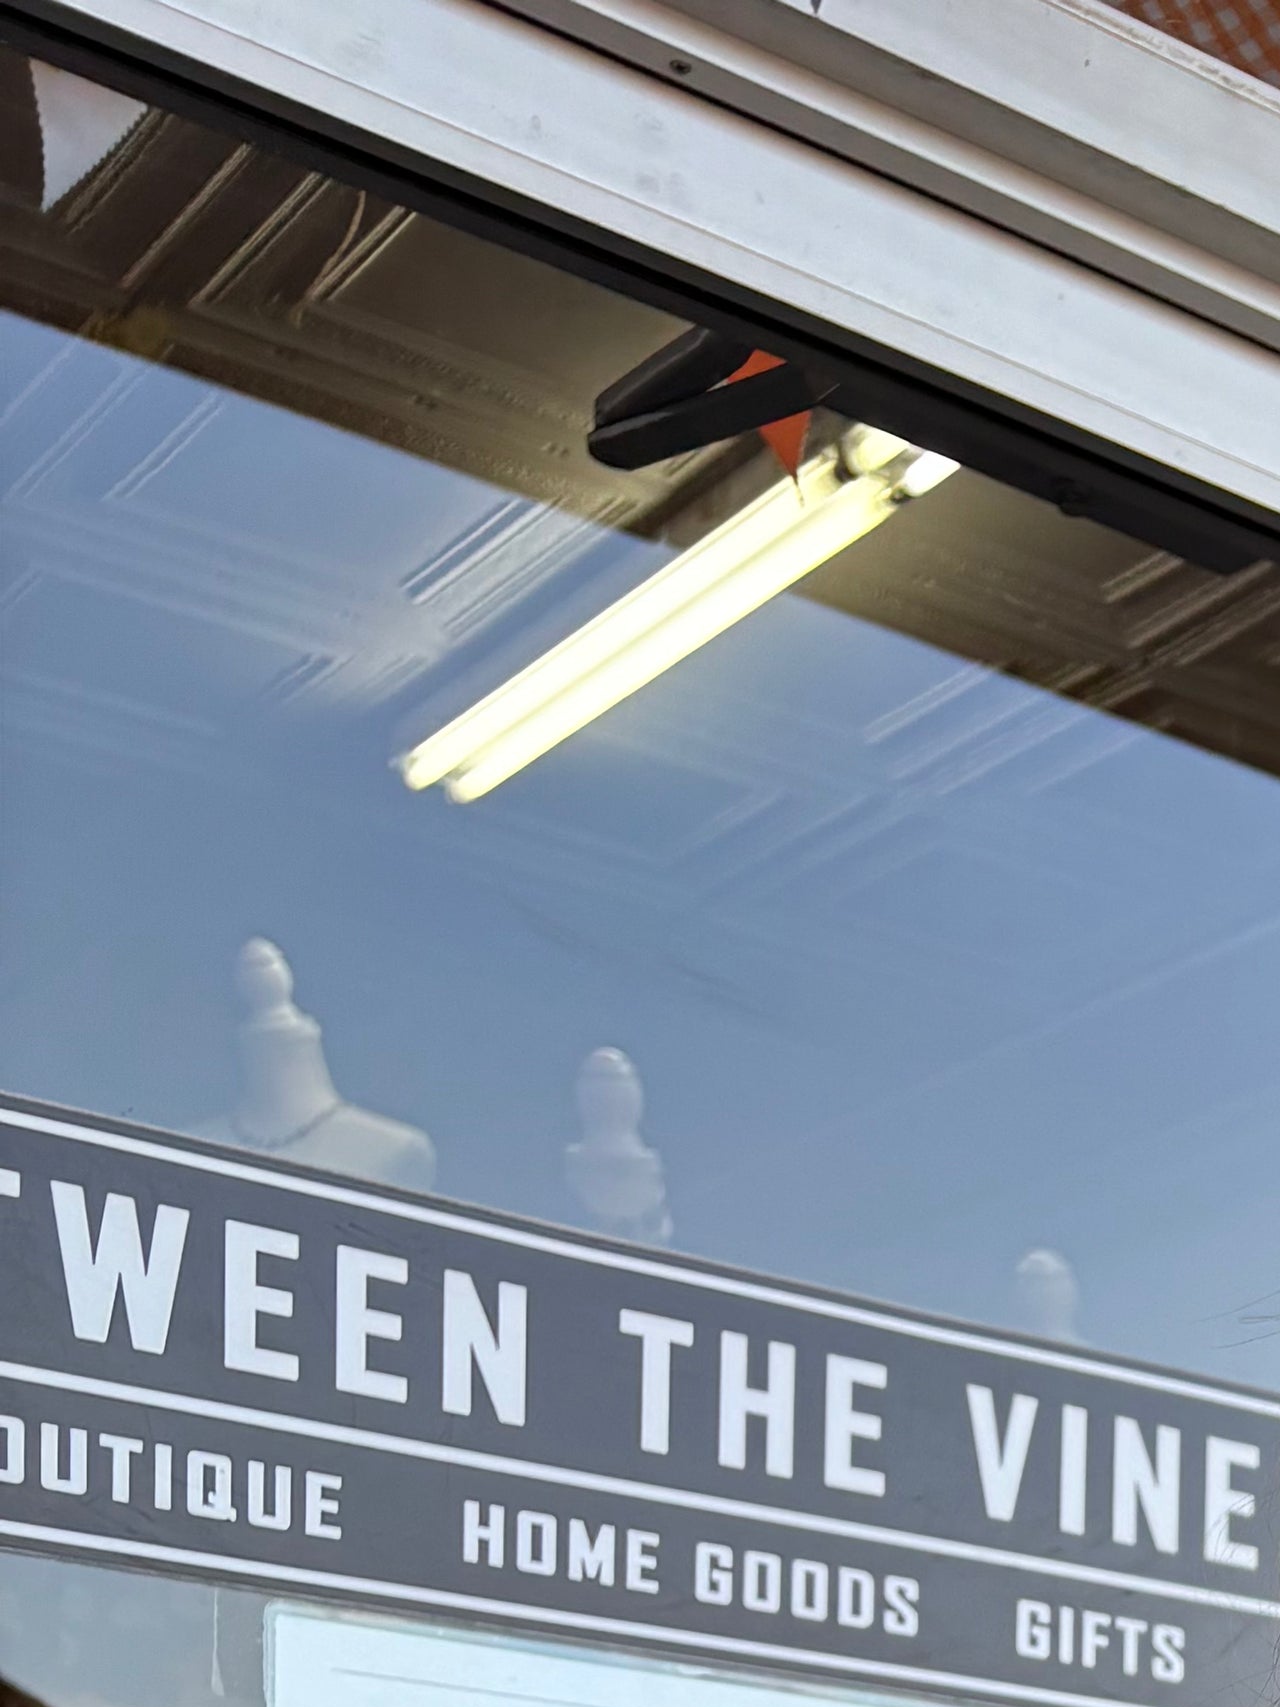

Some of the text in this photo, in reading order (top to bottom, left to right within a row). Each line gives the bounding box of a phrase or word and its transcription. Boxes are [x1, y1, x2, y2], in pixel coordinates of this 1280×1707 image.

[0, 1168, 527, 1428] WEEN
[619, 1307, 888, 1498] THE
[462, 1499, 661, 1595] HOME
[694, 1541, 920, 1638] GOODS
[1014, 1598, 1186, 1685] GIFTS
